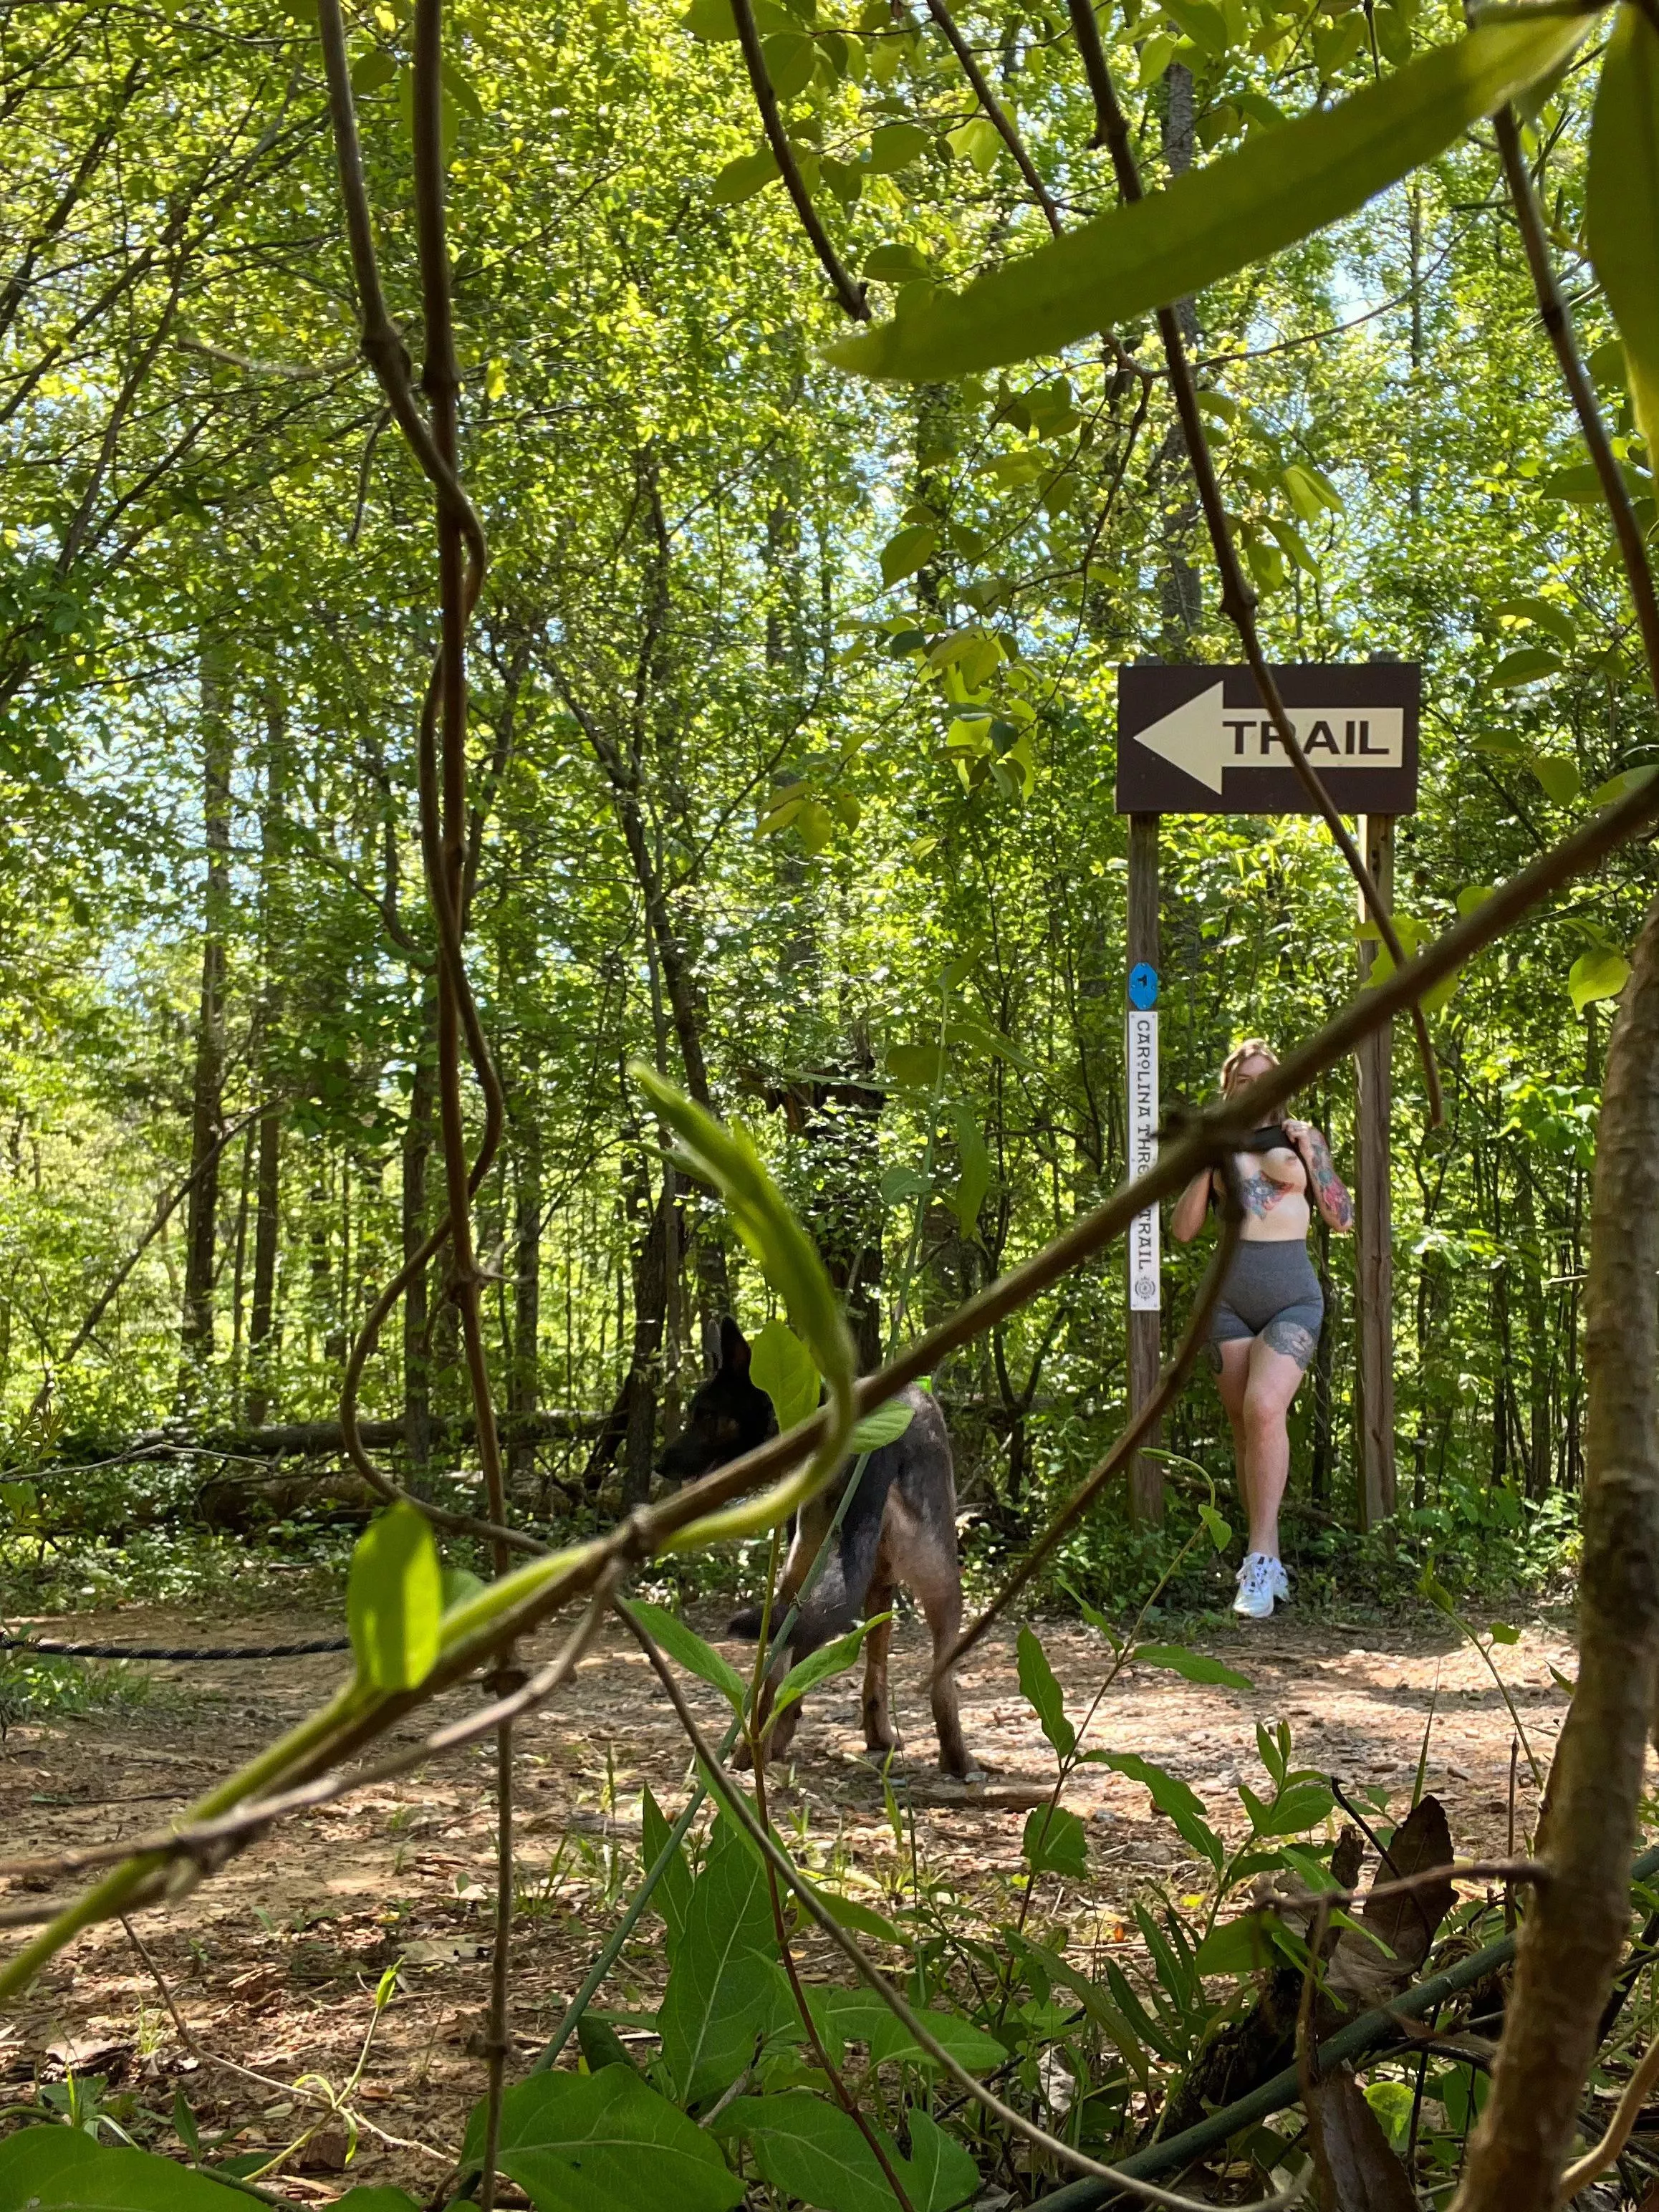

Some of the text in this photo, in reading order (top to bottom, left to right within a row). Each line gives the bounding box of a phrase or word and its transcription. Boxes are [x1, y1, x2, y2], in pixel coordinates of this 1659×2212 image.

[1137, 1020, 1152, 1270] CAROLINA THRE TRAIL
